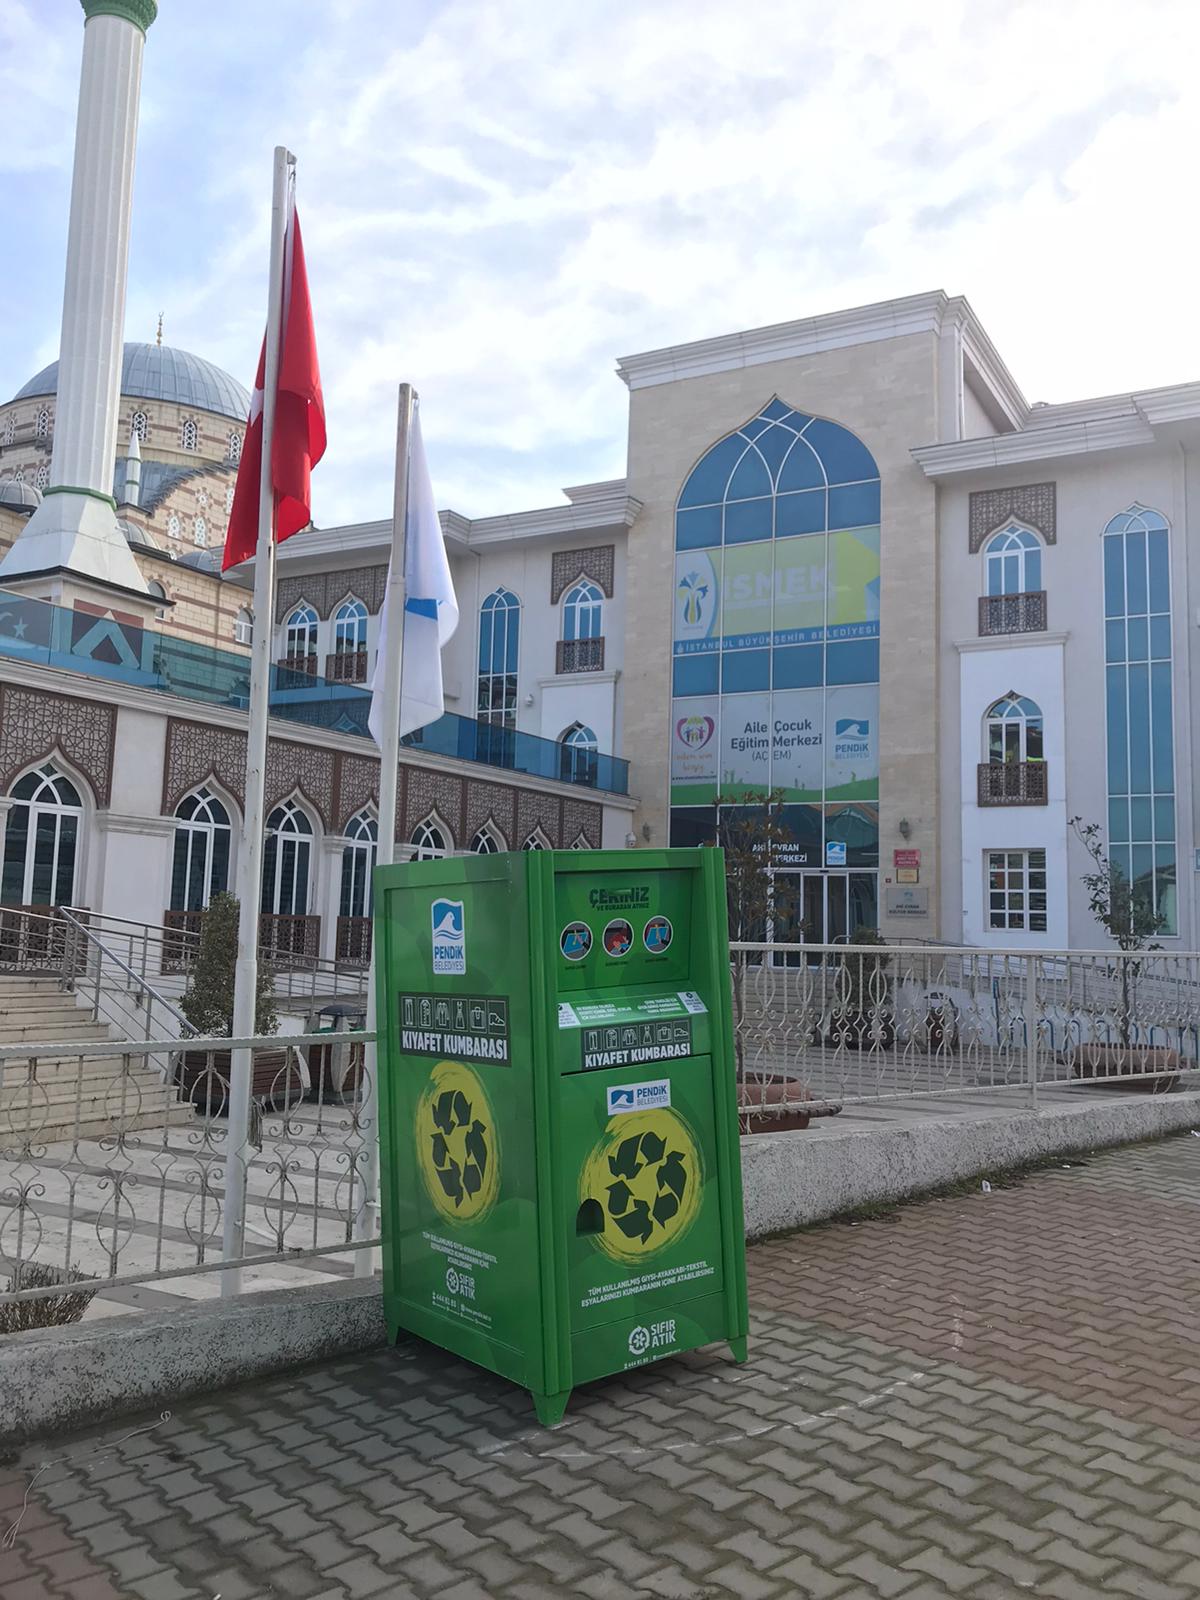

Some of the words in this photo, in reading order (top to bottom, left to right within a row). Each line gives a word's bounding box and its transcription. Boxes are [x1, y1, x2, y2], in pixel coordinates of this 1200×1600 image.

[744, 722, 768, 734] Aile
[774, 719, 812, 734] Çocuk
[731, 736, 770, 751] Eğitim
[773, 733, 823, 747] Merkezi
[402, 1030, 441, 1051] KIYAFET
[444, 1034, 508, 1060] KUMBARASI
[585, 1051, 630, 1068] KIYAFET
[631, 1043, 691, 1064] KUMBARASI
[460, 1273, 475, 1288] SIFIR
[460, 1285, 475, 1300] ATIK
[651, 1319, 676, 1336] SIFIR
[651, 1331, 676, 1348] ATIK
